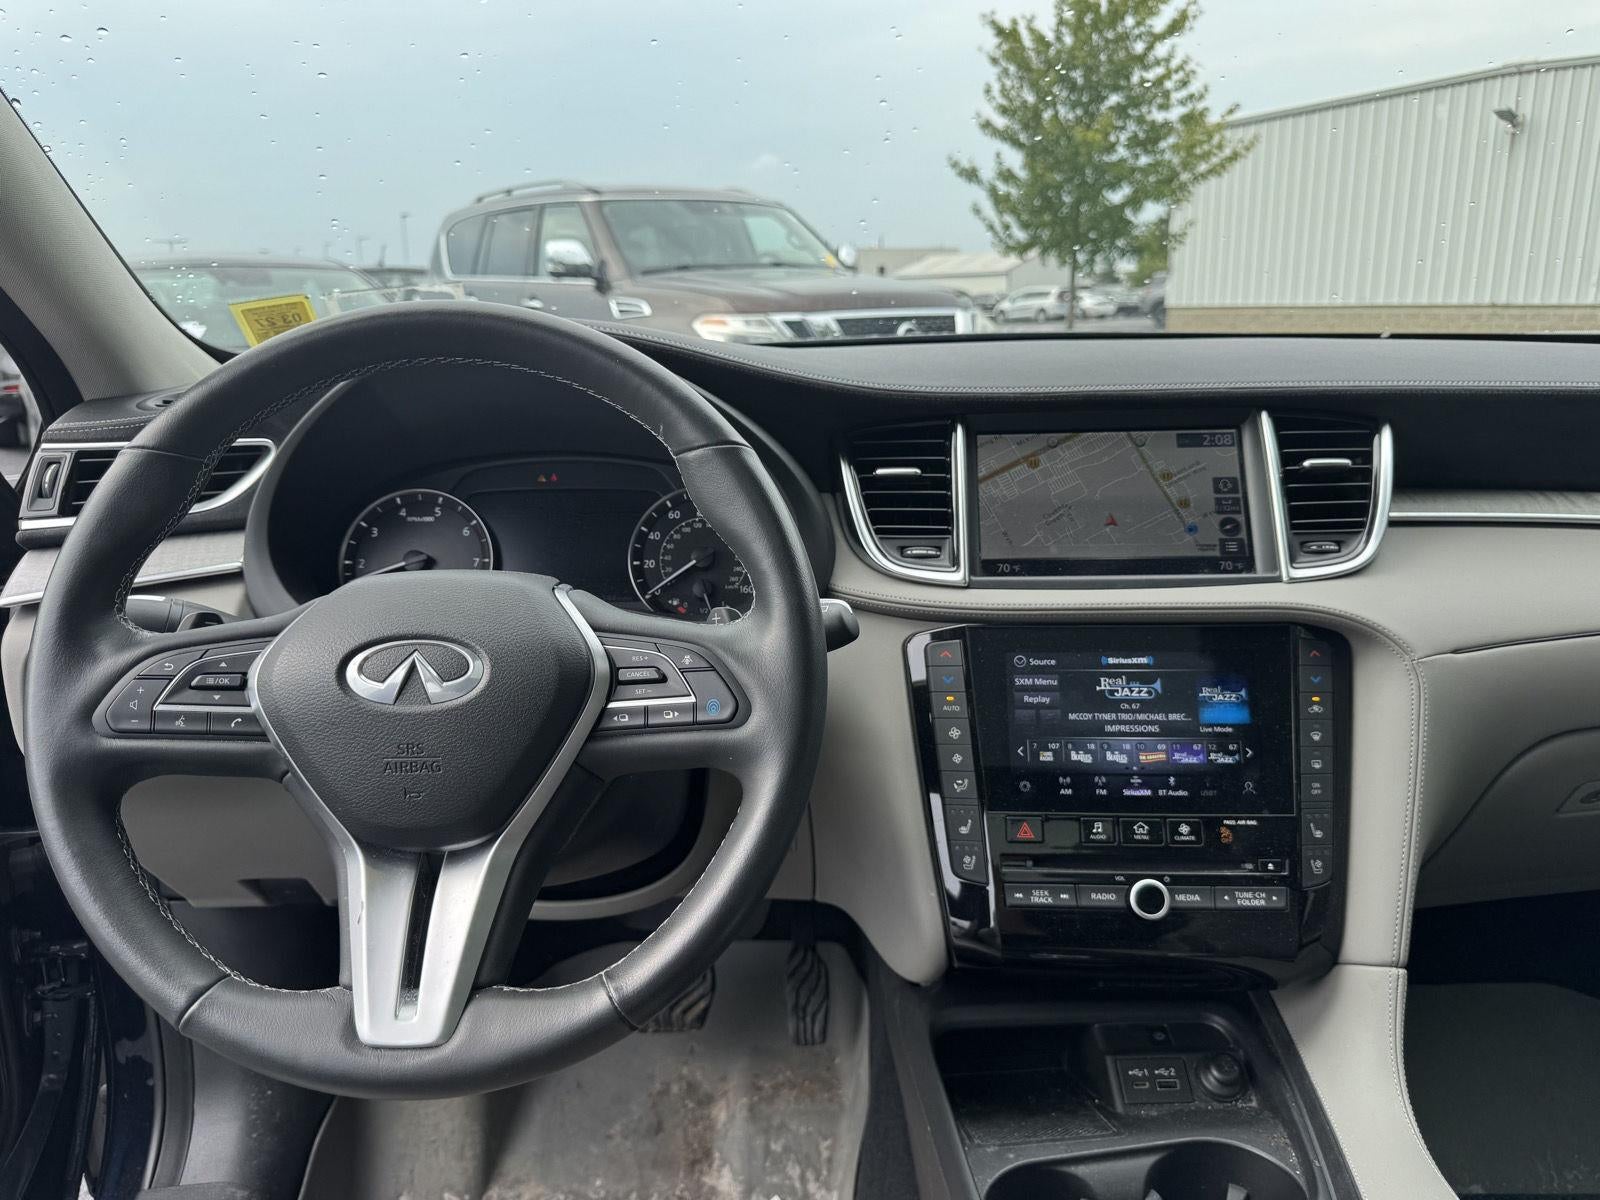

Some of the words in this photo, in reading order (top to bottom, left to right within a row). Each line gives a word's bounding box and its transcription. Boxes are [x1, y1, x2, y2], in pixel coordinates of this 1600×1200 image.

[1202, 434, 1232, 446] 2:08
[398, 508, 407, 517] 4
[434, 507, 442, 517] 5
[668, 510, 681, 519] 60
[371, 527, 378, 537] 3
[462, 527, 470, 537] 6
[648, 531, 661, 540] 40
[359, 559, 366, 569] 2
[473, 557, 480, 567] 7
[644, 559, 656, 568] 20
[1219, 561, 1233, 571] 70
[997, 563, 1010, 572] 70
[740, 585, 753, 594] 160
[1029, 658, 1057, 666] Source
[1014, 678, 1033, 686] SXM
[1034, 678, 1058, 686] Menu
[1100, 675, 1127, 688] Real
[1113, 687, 1149, 697] JAZZ
[1023, 695, 1050, 704] Replay
[1212, 693, 1237, 701] JAZZ
[1104, 725, 1160, 733] IMPRESSIONS
[397, 743, 426, 756] SRS
[383, 761, 443, 775] AIRBAG
[1090, 892, 1116, 900] RADIO
